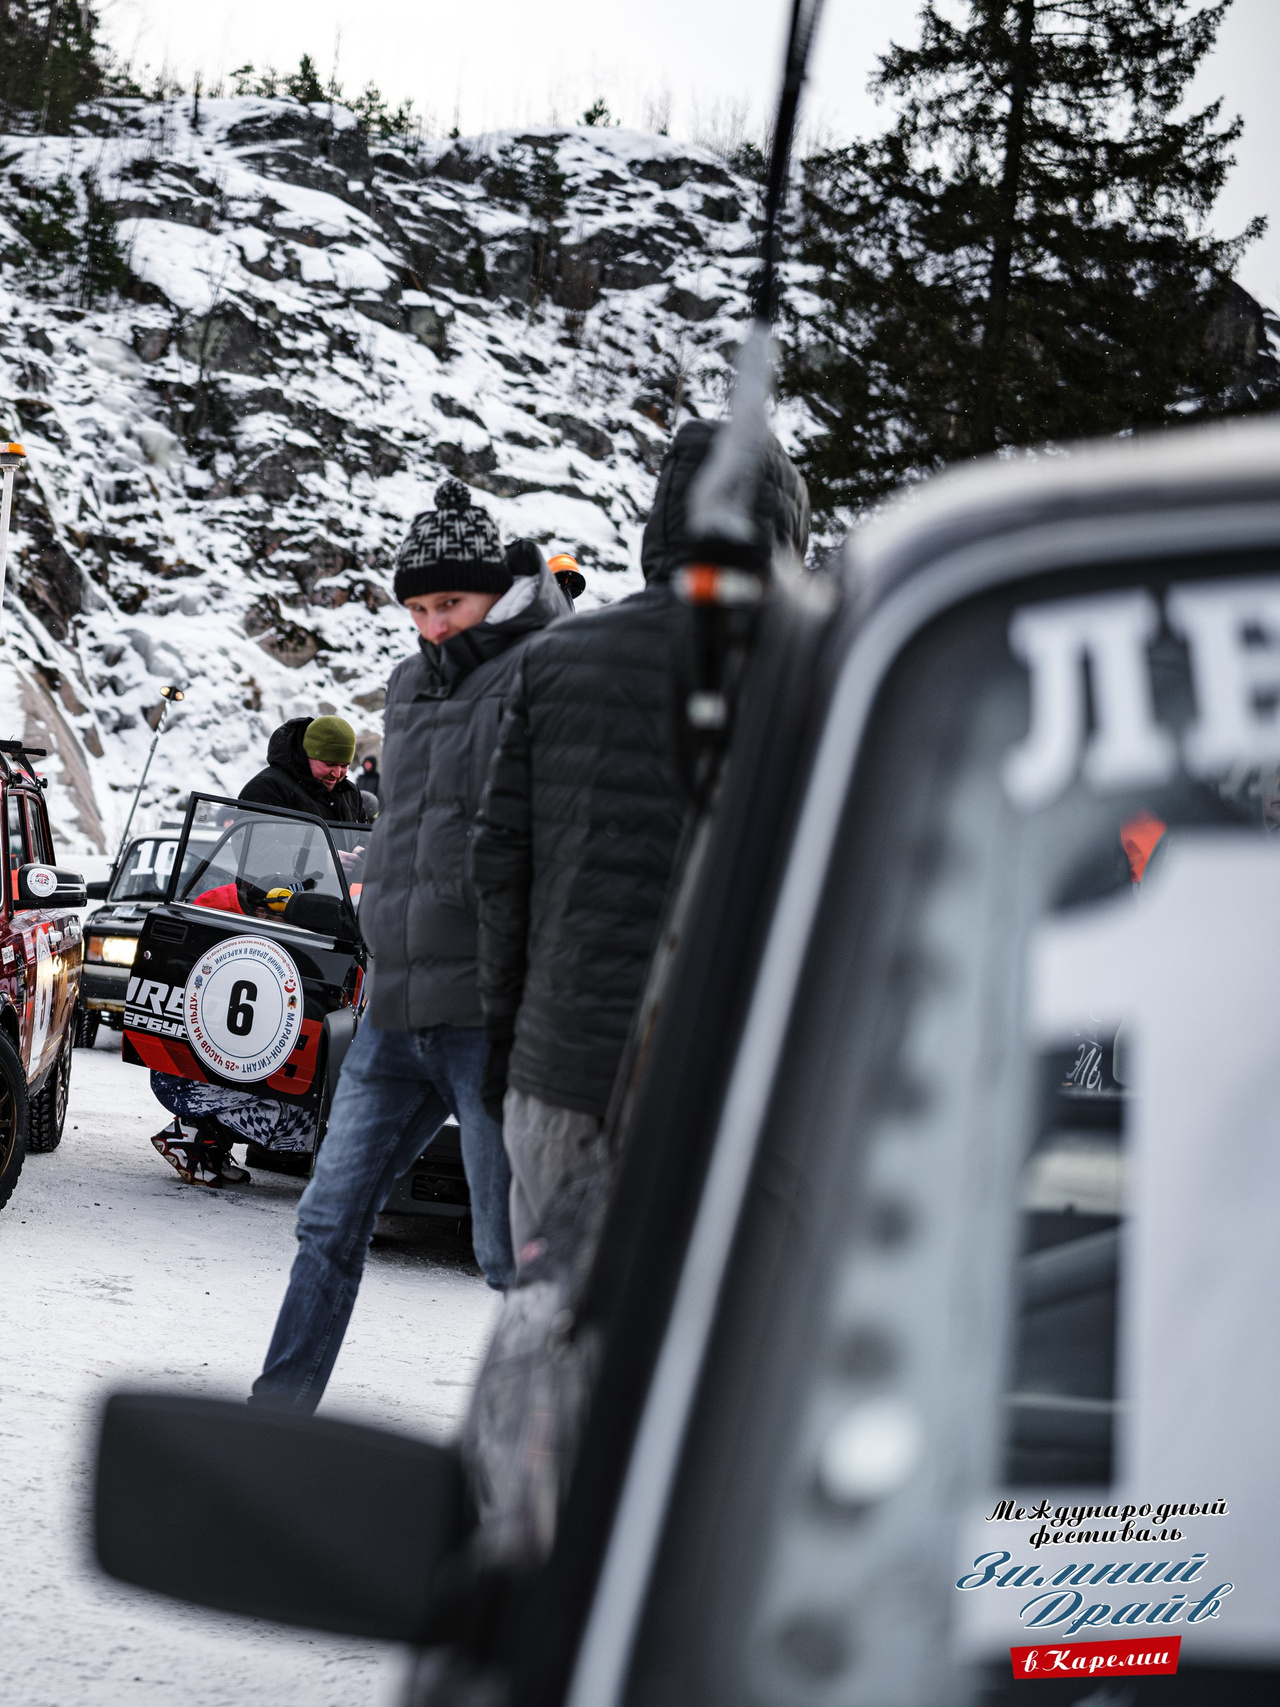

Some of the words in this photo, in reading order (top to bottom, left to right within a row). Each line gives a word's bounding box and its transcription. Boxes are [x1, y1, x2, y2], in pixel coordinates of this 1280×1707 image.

[214, 948, 243, 965] КАРЕЛИИ
[249, 947, 269, 959] ДРАЙВ
[267, 956, 286, 979] ЗИМНИЙ
[194, 1026, 204, 1041] НА
[242, 1012, 295, 1073] МАРАФОН-ГИГАНТ
[200, 1040, 223, 1066] ЧАСОВ
